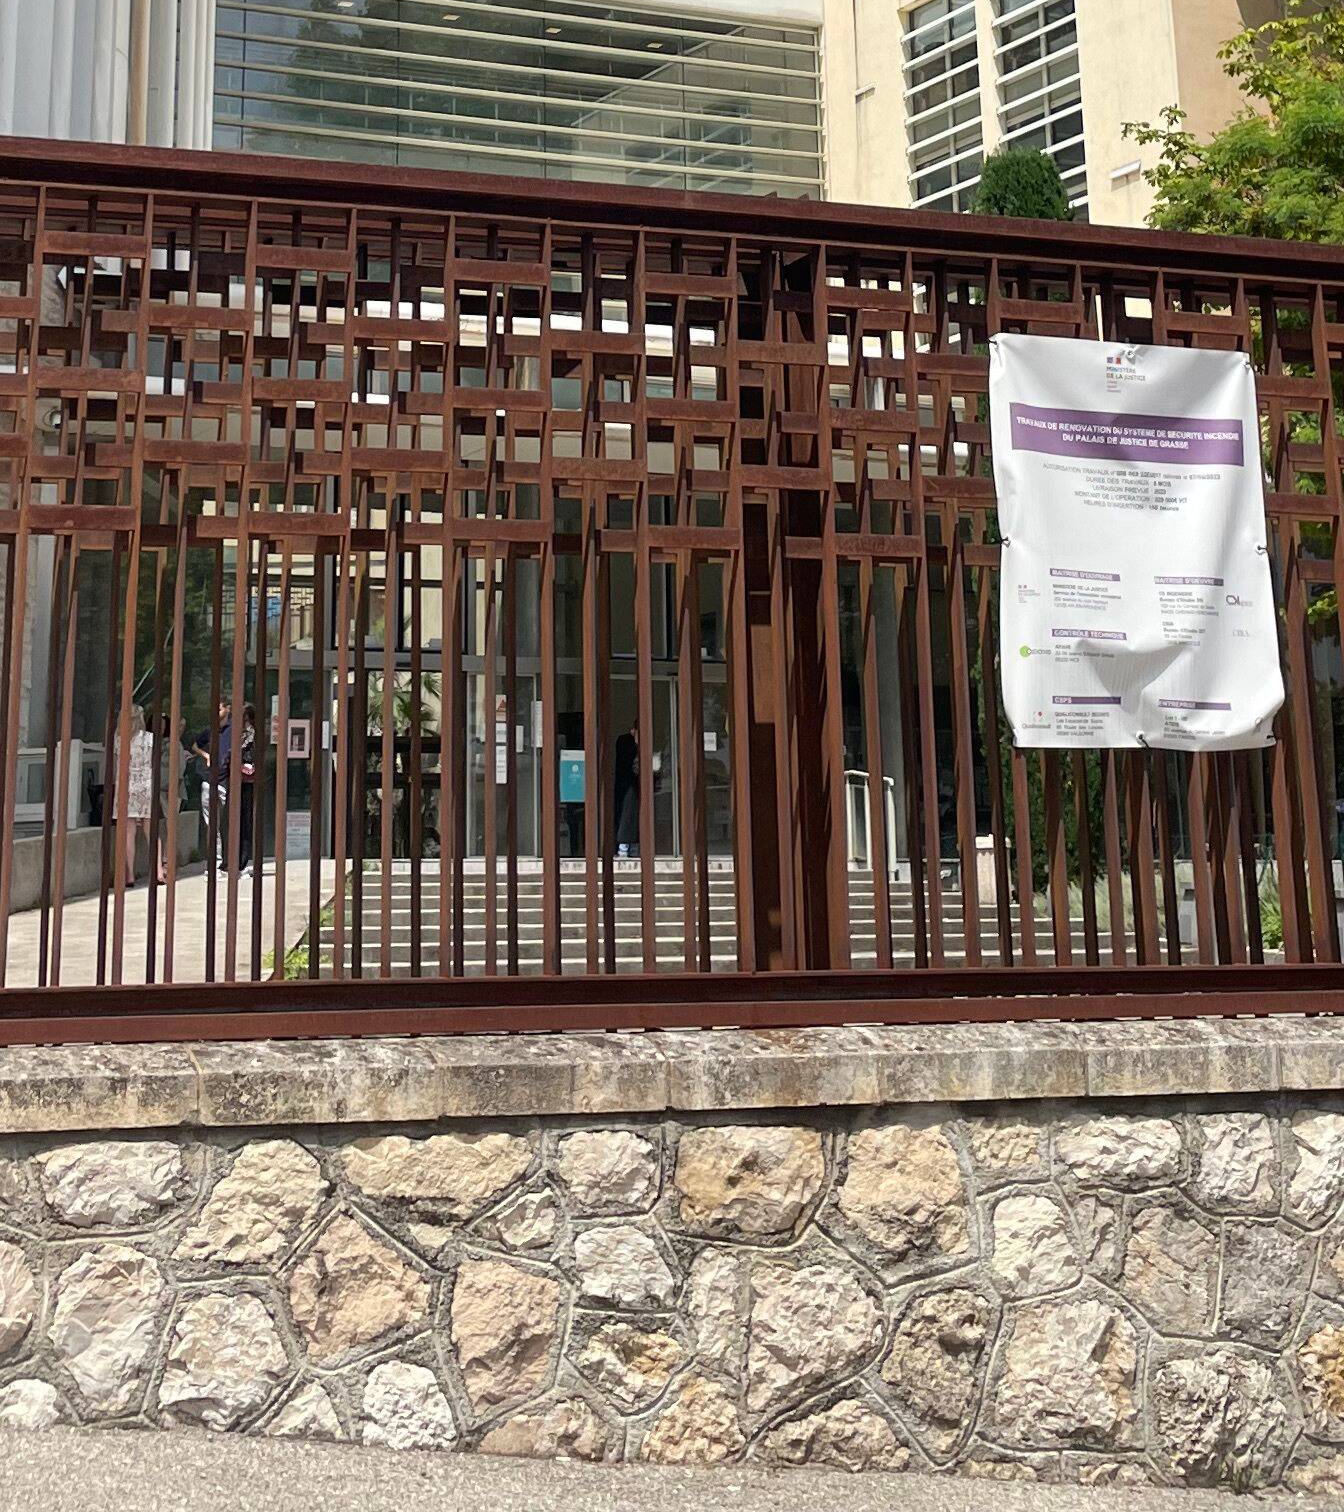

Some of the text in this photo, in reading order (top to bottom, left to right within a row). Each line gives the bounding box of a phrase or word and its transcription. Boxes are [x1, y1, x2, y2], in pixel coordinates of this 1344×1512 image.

[1016, 416, 1046, 429] TRAVAUX
[1047, 422, 1057, 430] DE
[1059, 423, 1112, 434] RENOVATION
[1113, 426, 1122, 435] DU
[1156, 429, 1166, 437] DE
[1063, 433, 1189, 449] DU PALAIS DE JUSTICE DE GRASSE
